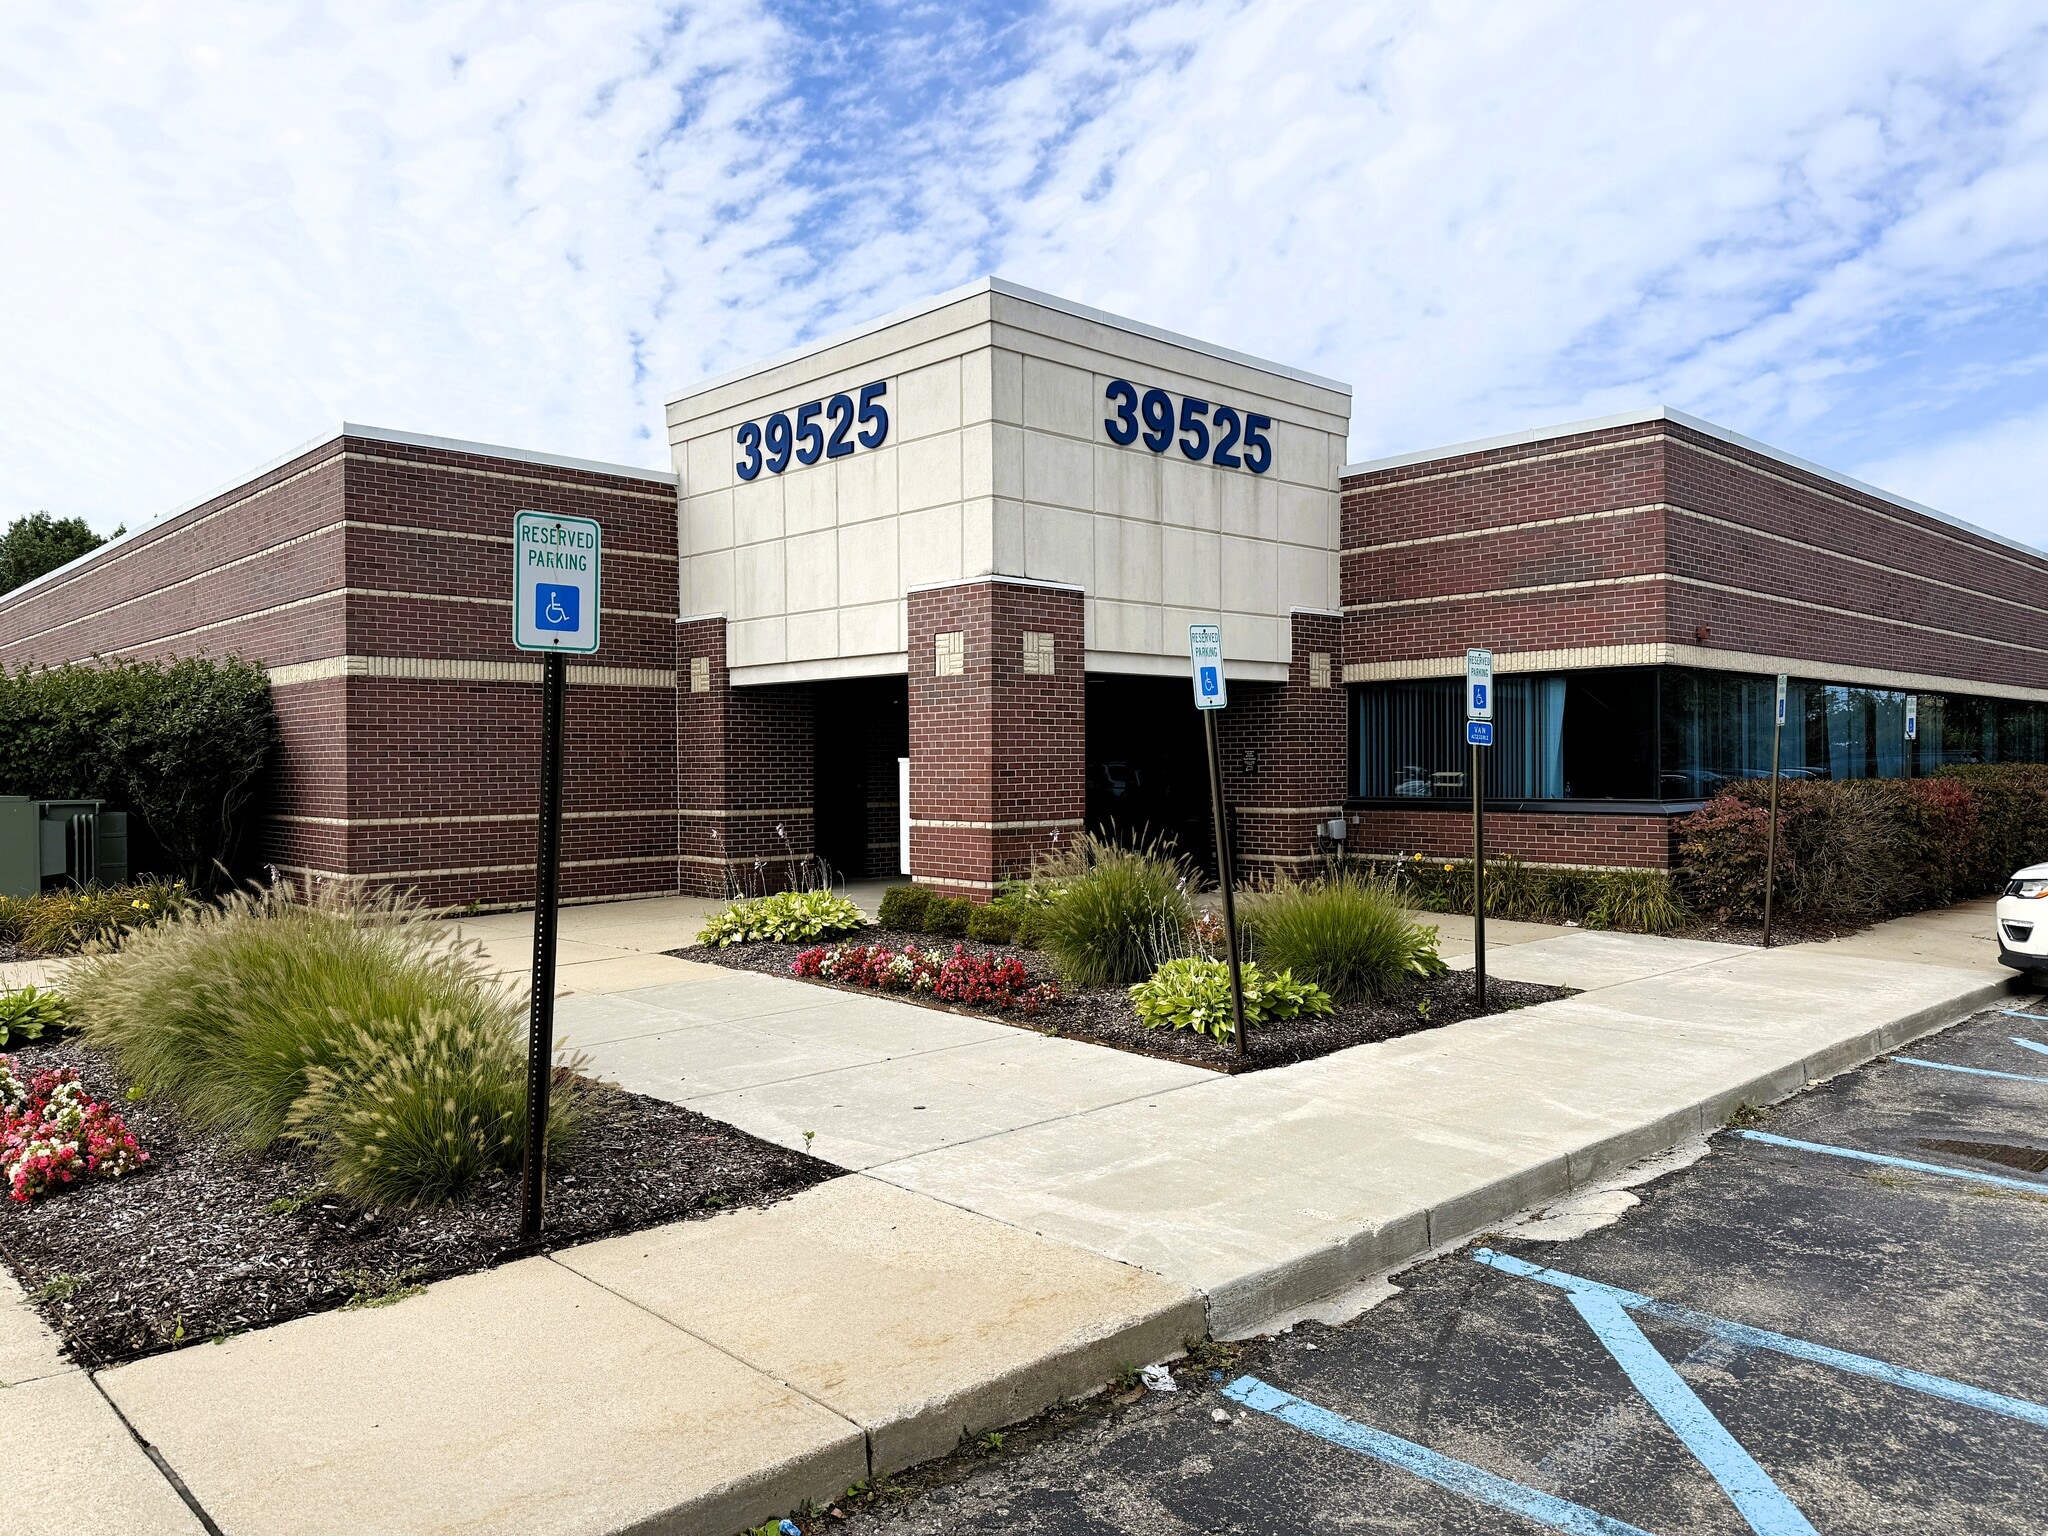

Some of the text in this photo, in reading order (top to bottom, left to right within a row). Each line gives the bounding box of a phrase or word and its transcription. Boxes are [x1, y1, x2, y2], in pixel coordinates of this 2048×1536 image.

[736, 381, 889, 481] 39525
[1104, 380, 1272, 474] 39525
[522, 525, 594, 549] RESERVED
[528, 549, 587, 572] PARKING
[1191, 632, 1219, 643] RESERVED
[1195, 647, 1218, 657] PARKING
[1469, 655, 1490, 666] RESERVED
[1471, 667, 1488, 677] PARKING
[1474, 726, 1487, 734] VAN
